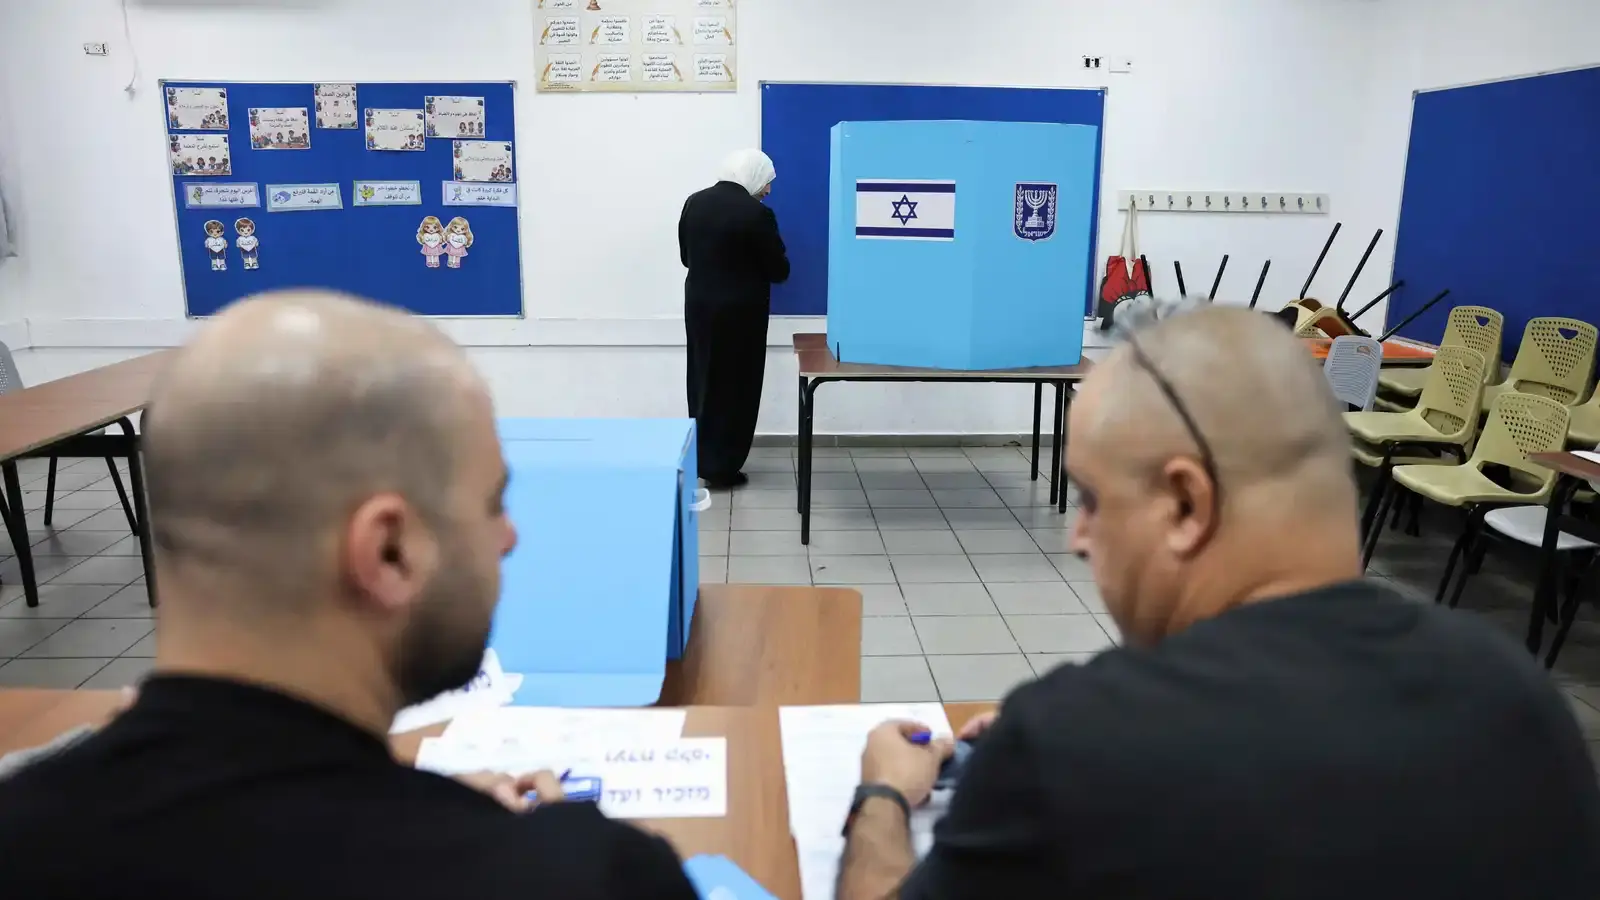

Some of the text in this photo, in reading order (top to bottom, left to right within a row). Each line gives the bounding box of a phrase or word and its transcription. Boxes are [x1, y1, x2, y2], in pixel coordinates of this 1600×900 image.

[1022, 227, 1048, 237] ישראל
[606, 784, 710, 802] מזכיר ועד
